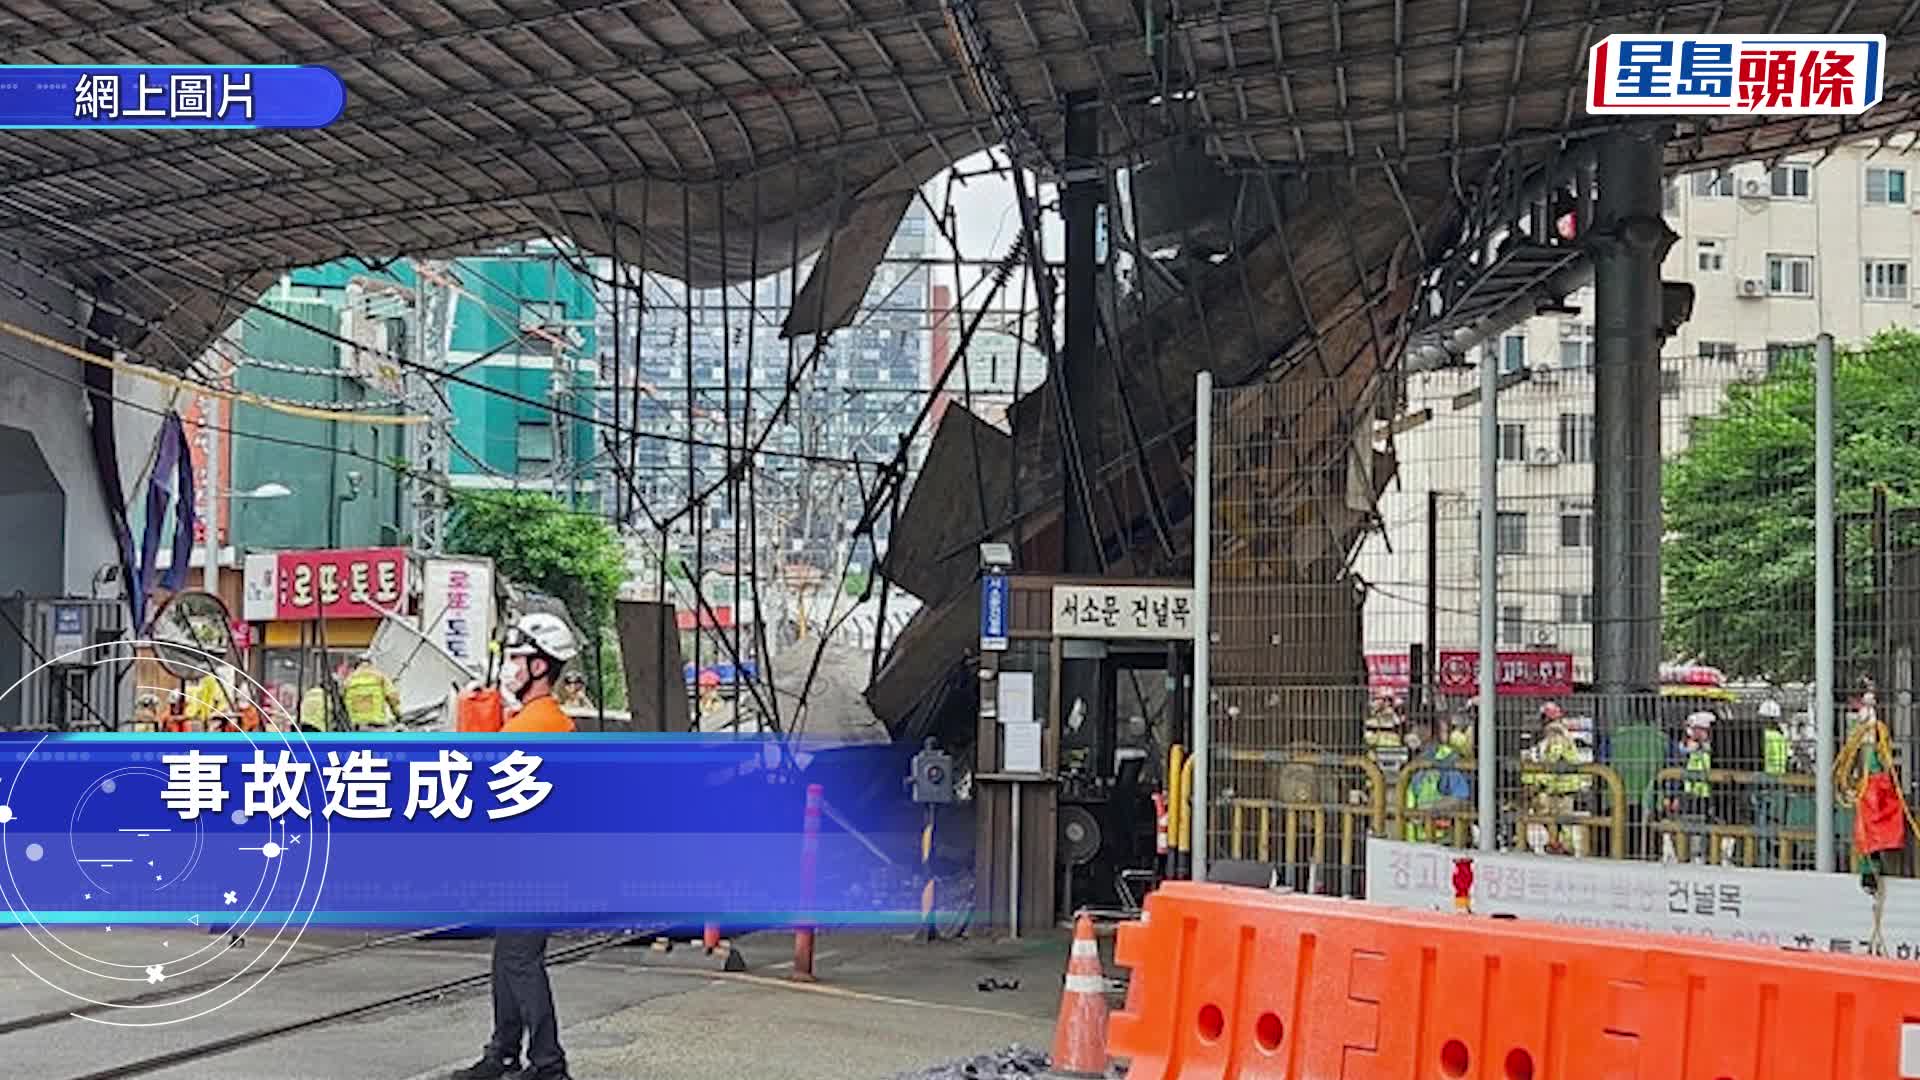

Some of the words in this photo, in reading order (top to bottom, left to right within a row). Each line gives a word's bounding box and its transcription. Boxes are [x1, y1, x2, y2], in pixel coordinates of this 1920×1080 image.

[1060, 594, 1120, 628] 서소문
[1130, 594, 1190, 629] 건널목
[1667, 879, 1743, 919] 건널목
